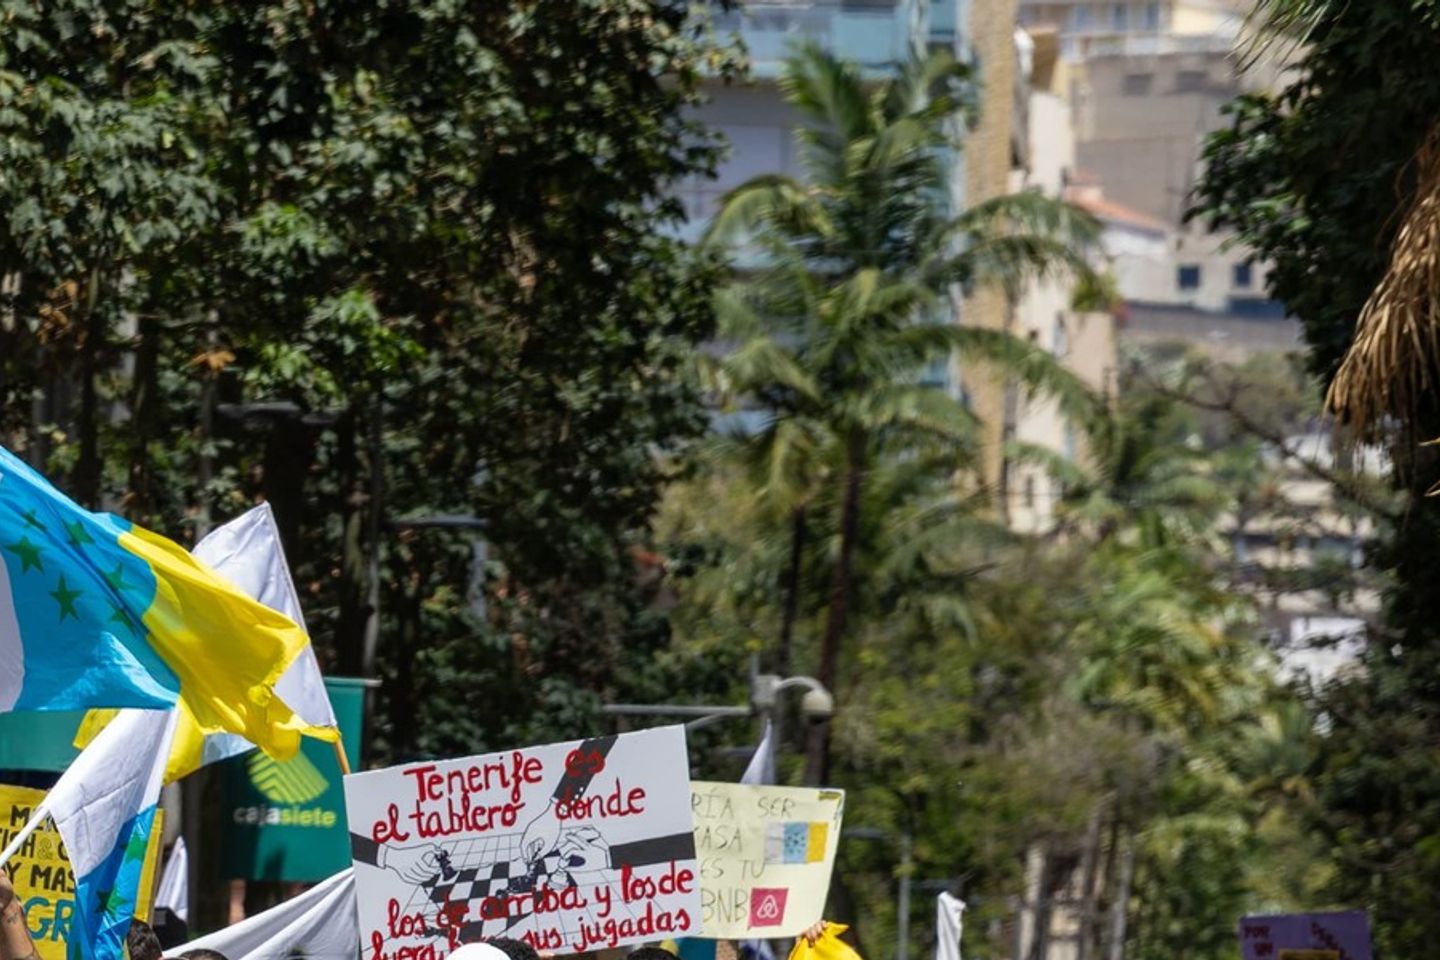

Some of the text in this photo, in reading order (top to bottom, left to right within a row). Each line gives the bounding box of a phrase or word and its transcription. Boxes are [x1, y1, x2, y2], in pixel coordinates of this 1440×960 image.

[403, 749, 606, 803] Tenerife es
[233, 804, 337, 828] cajasiete
[372, 777, 646, 844] el tablero donde
[757, 796, 796, 819] SER
[387, 898, 428, 940] los
[596, 884, 613, 917] y
[572, 902, 692, 953] jugadas
